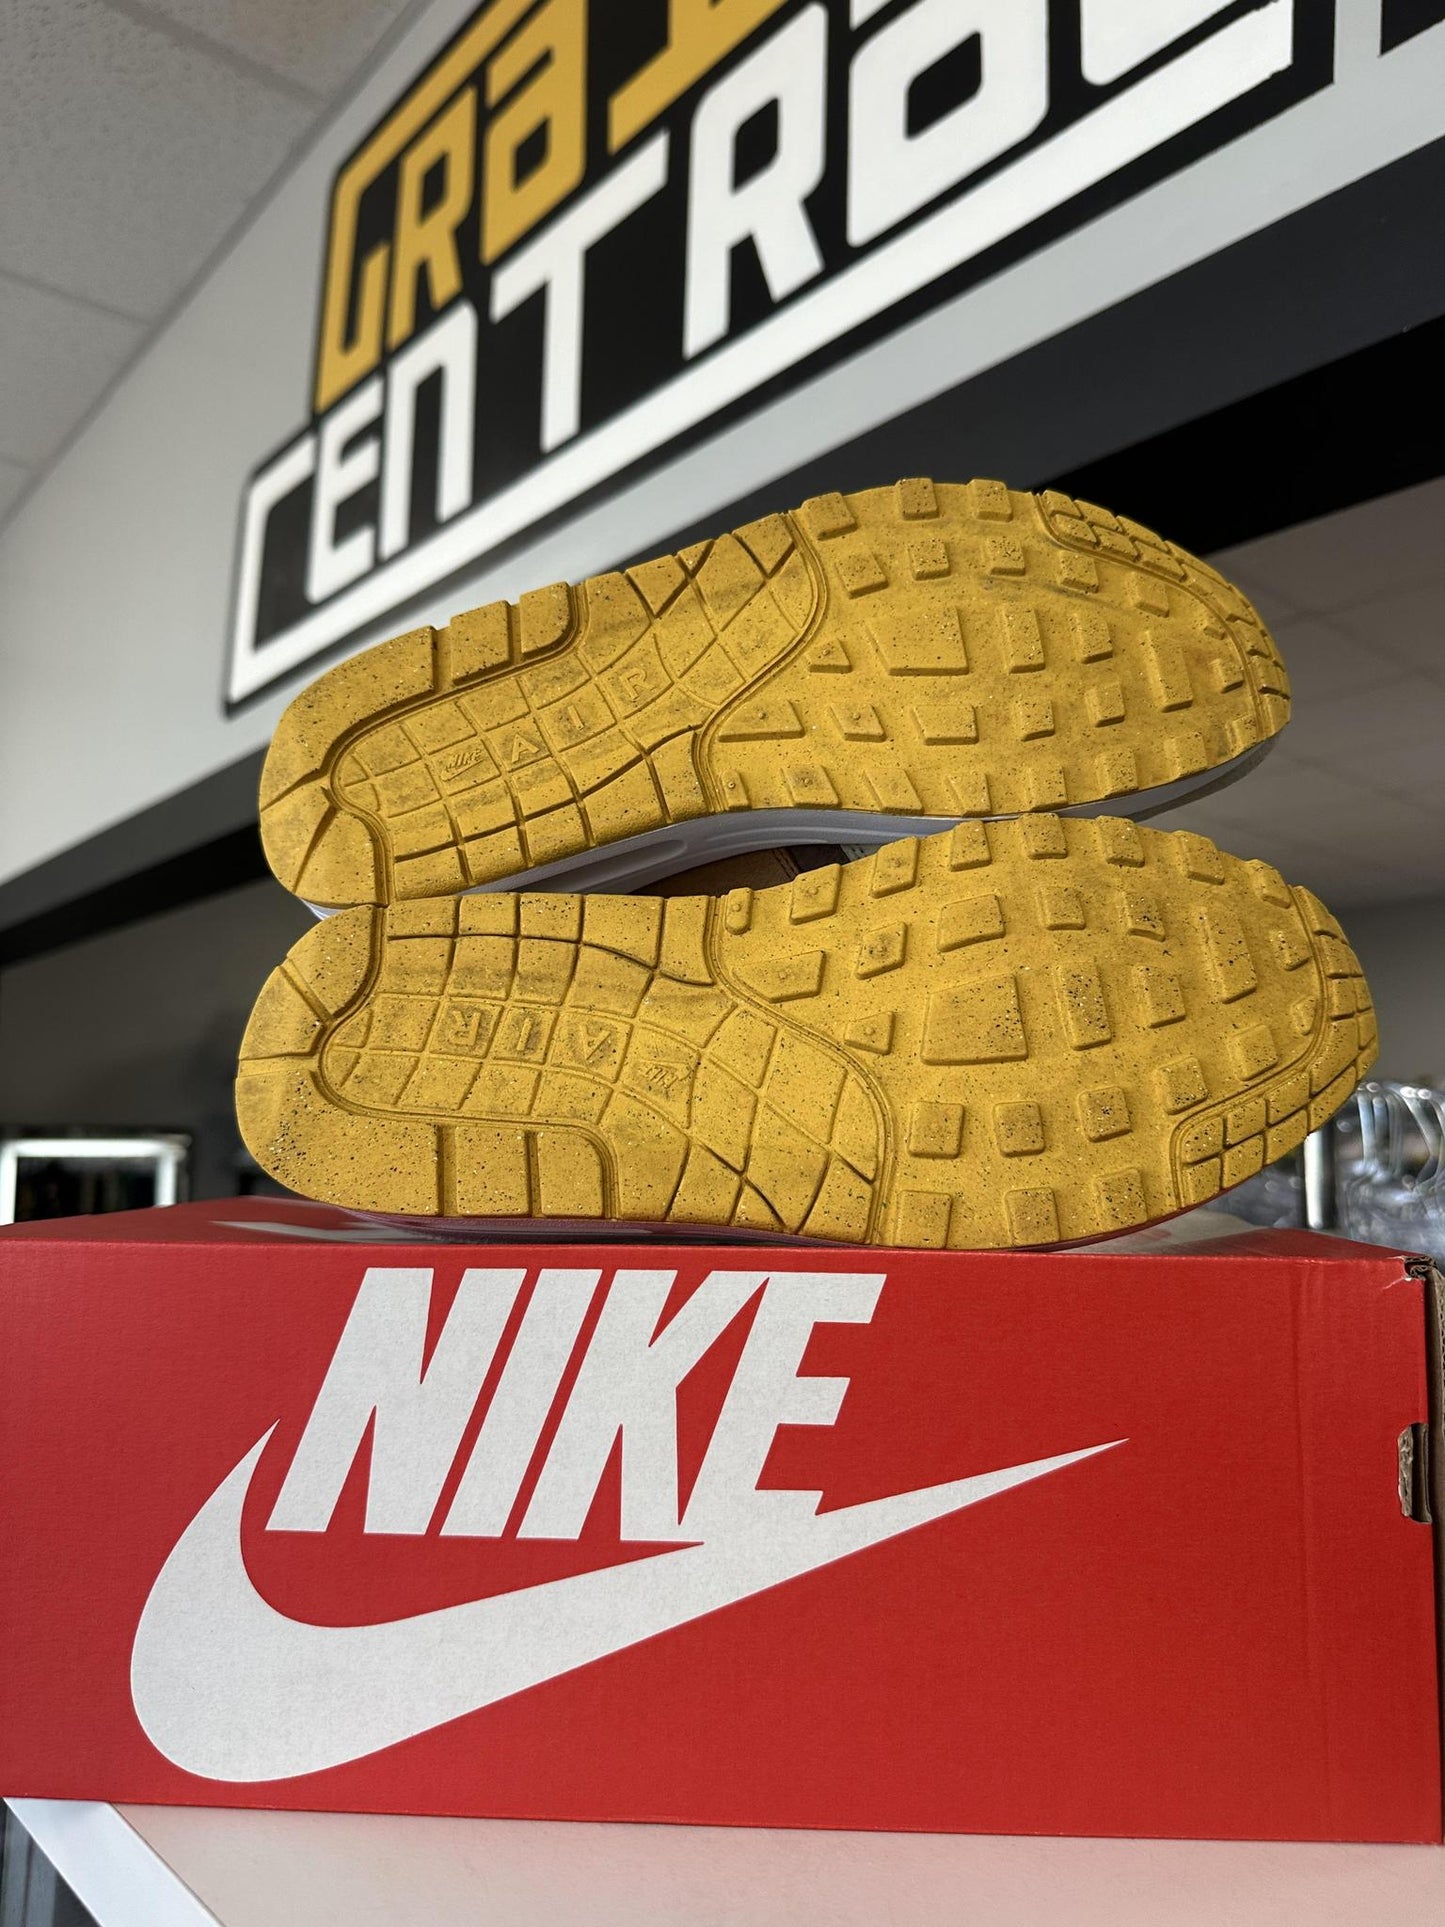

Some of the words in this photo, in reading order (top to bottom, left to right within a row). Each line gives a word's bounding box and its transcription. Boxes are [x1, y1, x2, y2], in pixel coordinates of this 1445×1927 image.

[510, 667, 656, 763] AIR
[452, 1009, 613, 1061] AIR
[265, 1268, 887, 1544] NIKE
